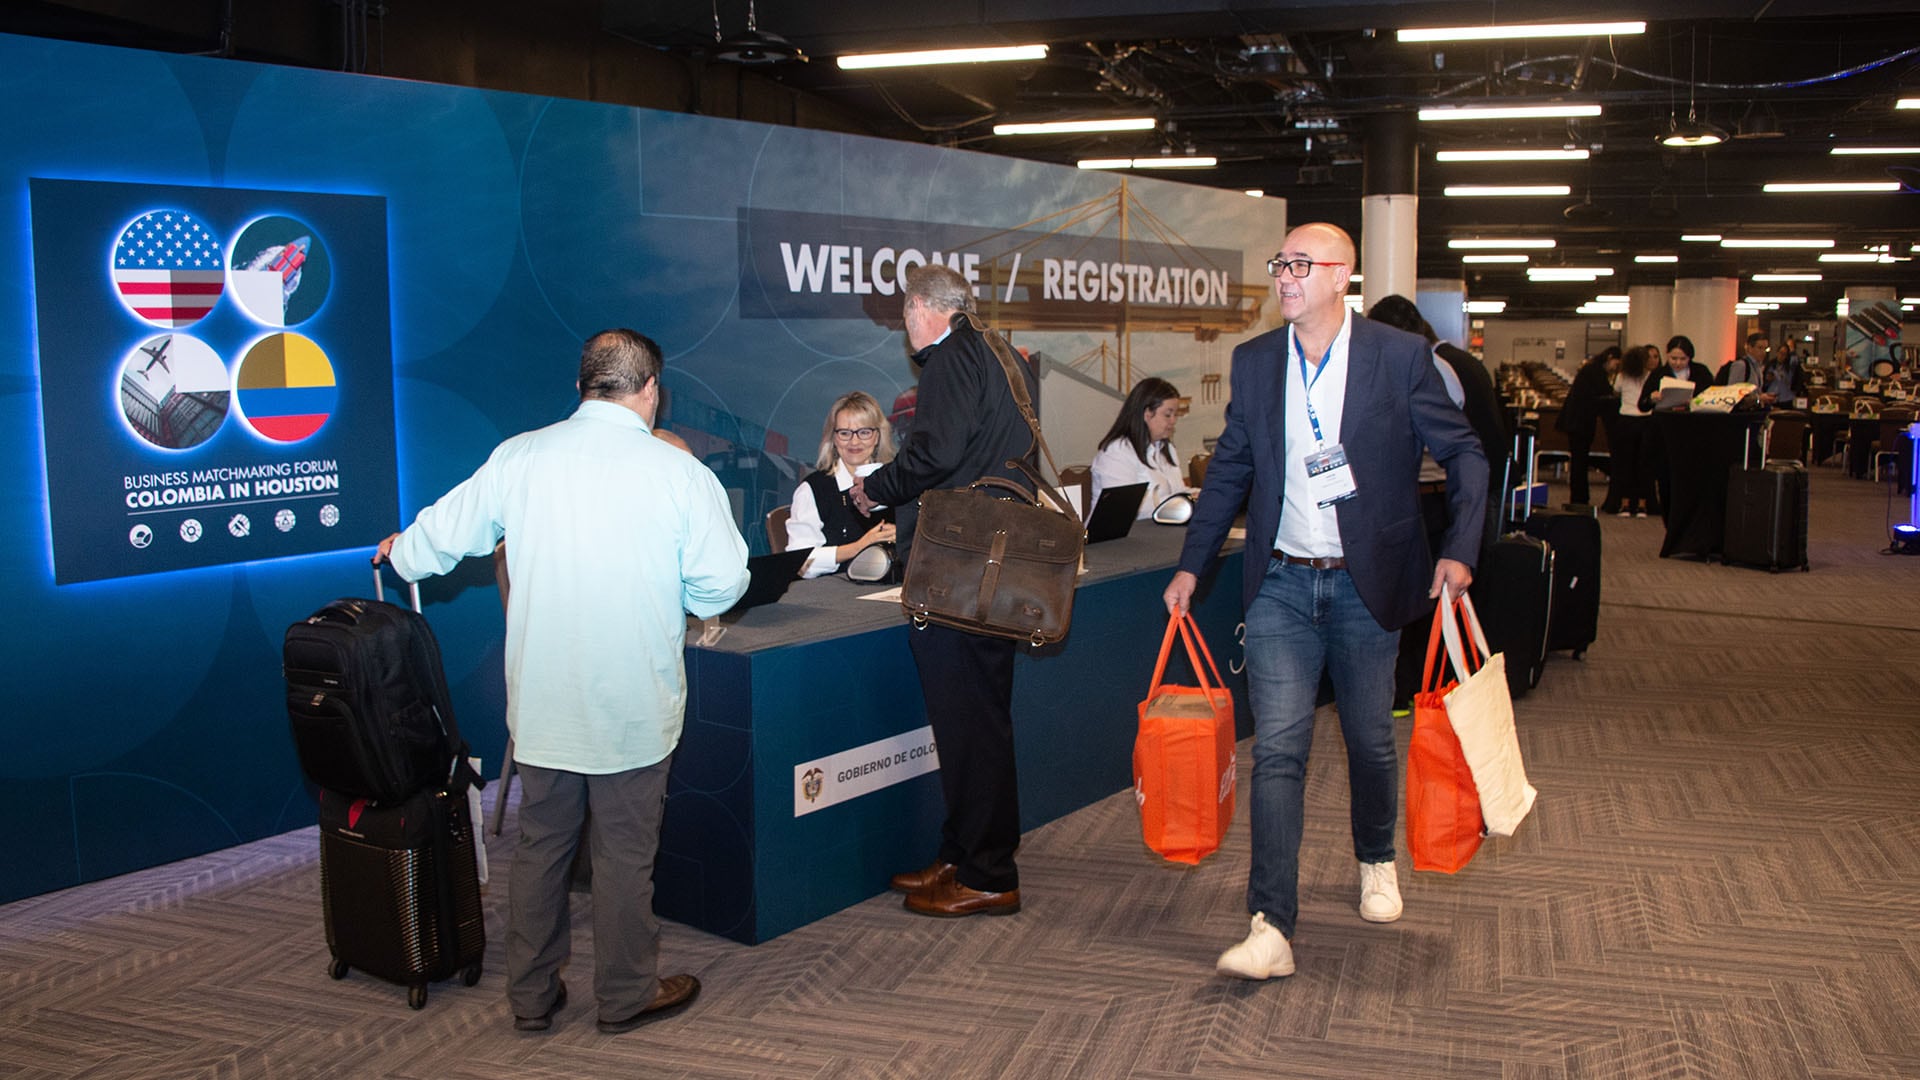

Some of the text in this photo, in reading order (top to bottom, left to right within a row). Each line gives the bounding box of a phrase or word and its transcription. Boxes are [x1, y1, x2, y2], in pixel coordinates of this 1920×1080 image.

[1043, 258, 1228, 306] REGISTRATION
[124, 459, 338, 489] BUSINESS MATCHMAKING FORUM
[126, 474, 339, 508] COLOMBIA IN HOUSTON
[837, 756, 891, 783] GOBIERNO
[894, 751, 908, 765] DE
